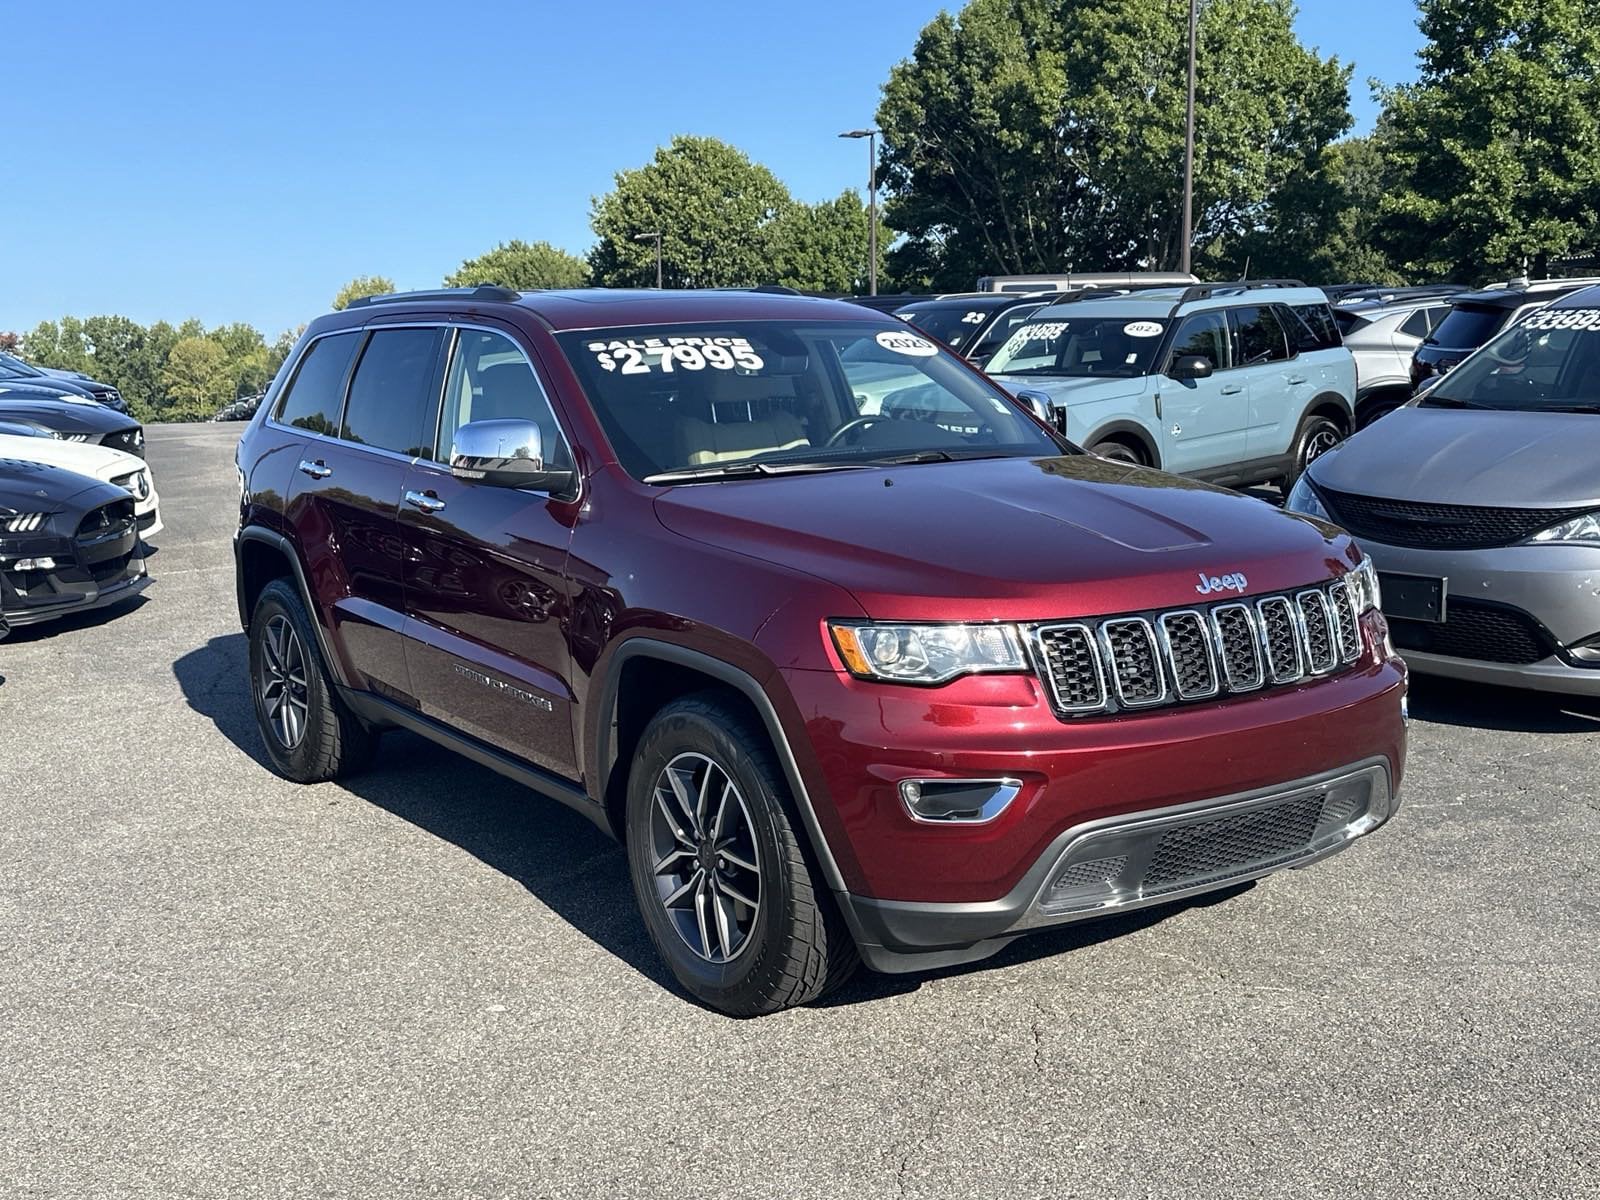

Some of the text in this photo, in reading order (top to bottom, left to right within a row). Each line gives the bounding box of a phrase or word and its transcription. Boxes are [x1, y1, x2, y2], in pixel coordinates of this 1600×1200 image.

[961, 311, 985, 324] 23
[588, 337, 752, 352] SALE PRICE
[881, 338, 932, 349] 2020
[597, 344, 764, 375] $27995
[1196, 572, 1248, 595] Jeep
